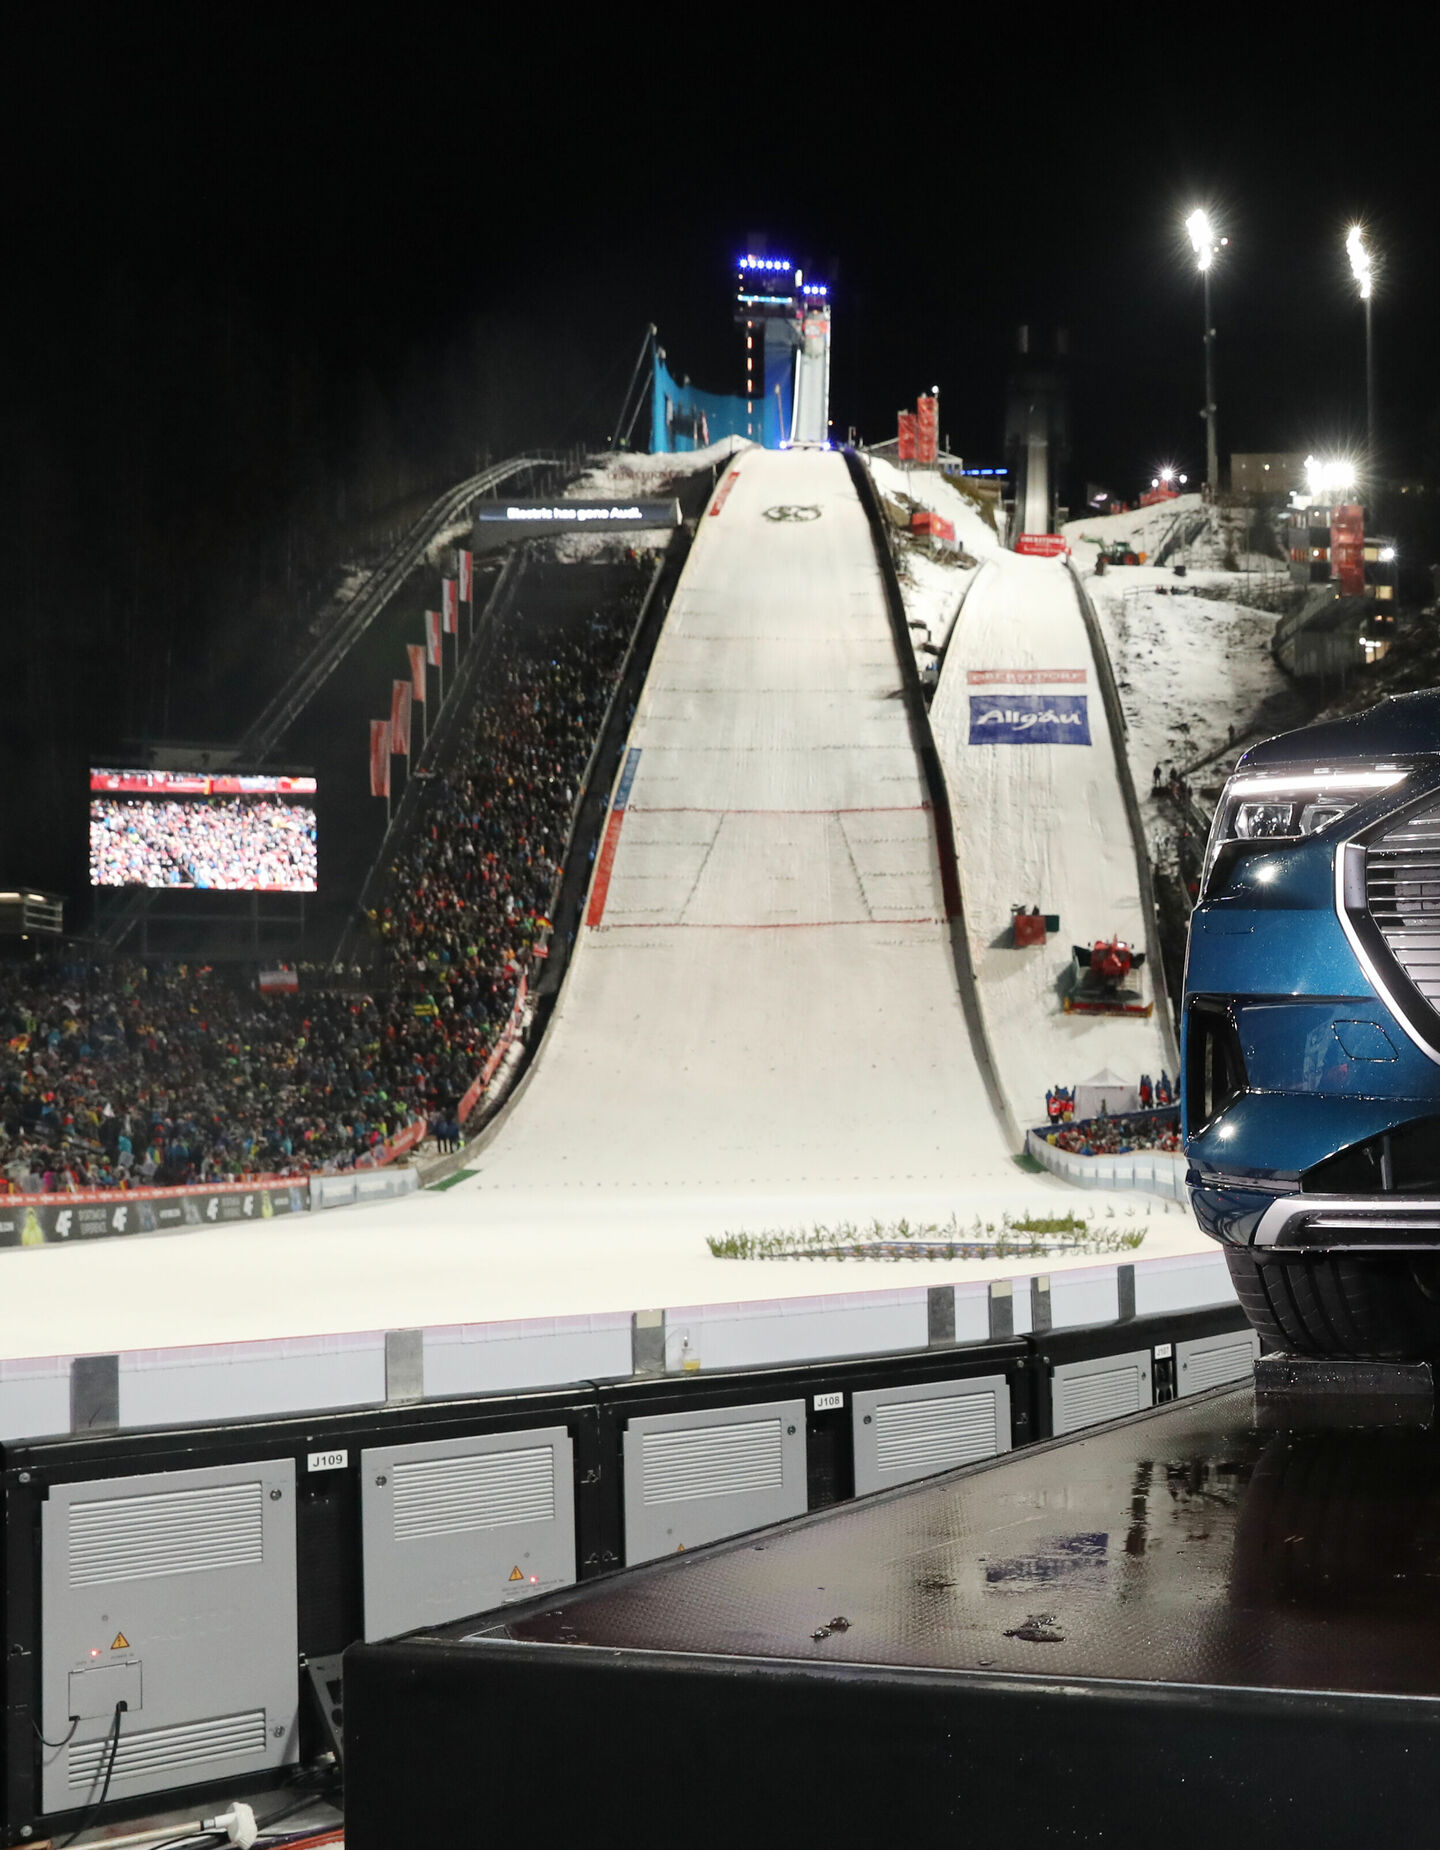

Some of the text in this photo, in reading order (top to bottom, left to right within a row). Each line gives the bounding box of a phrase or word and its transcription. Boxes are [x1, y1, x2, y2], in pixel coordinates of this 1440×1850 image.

[977, 709, 1082, 731] Allgäu
[817, 1396, 840, 1407] J108
[312, 1454, 343, 1467] J109
